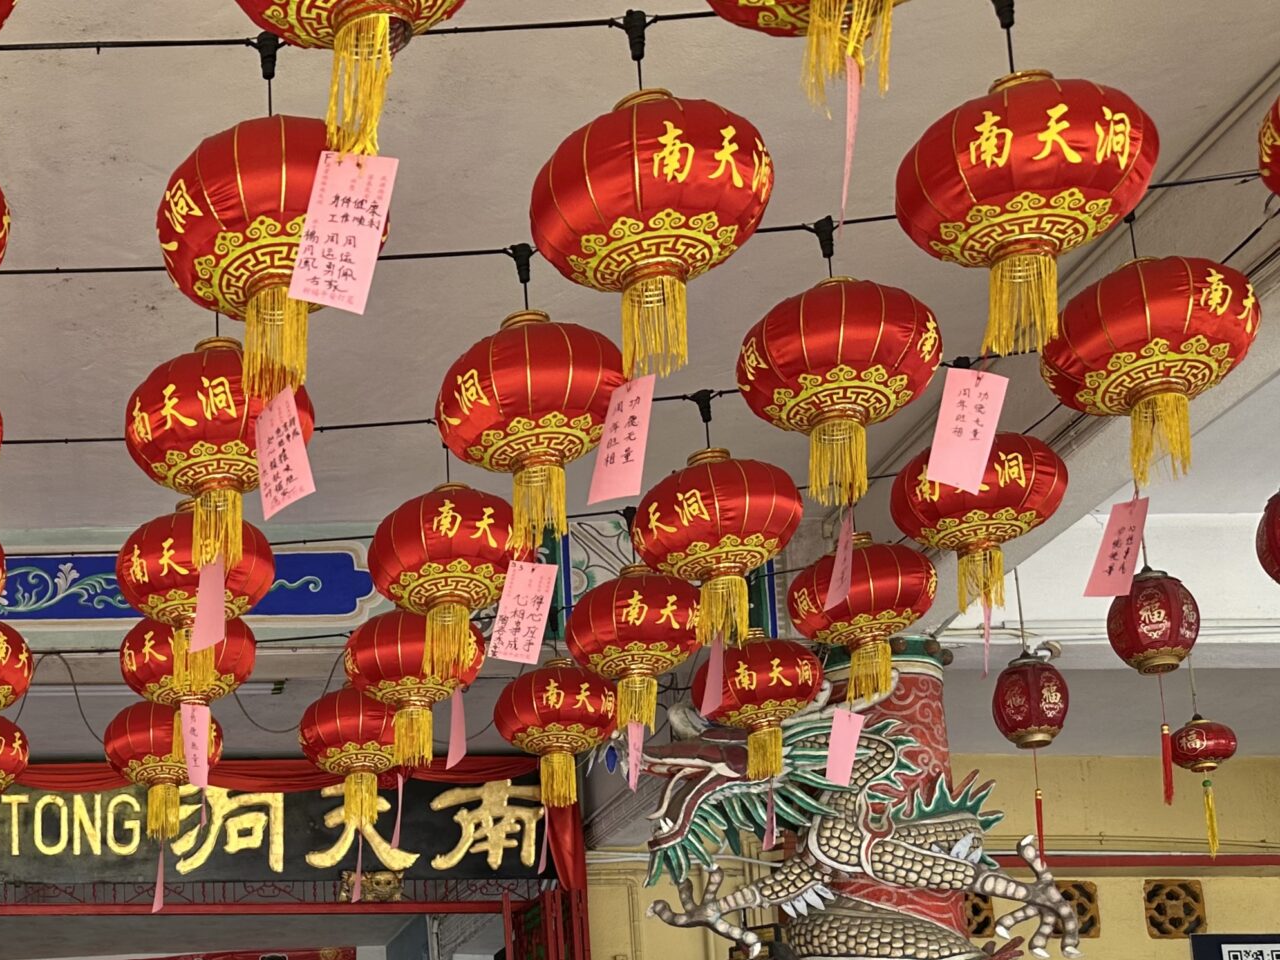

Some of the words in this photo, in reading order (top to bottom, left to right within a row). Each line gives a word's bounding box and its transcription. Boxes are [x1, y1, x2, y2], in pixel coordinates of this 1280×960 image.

[970, 104, 1130, 170] 南天洞
[652, 121, 770, 202] 南天洞
[132, 376, 236, 442] 南天洞
[916, 451, 1025, 502] 南洞
[1139, 602, 1166, 624] 福
[734, 658, 812, 690] 南天洞
[1042, 686, 1061, 704] 福
[543, 679, 615, 719] 南天洞
[1179, 731, 1202, 750] 福
[1, 793, 141, 856] TONG
